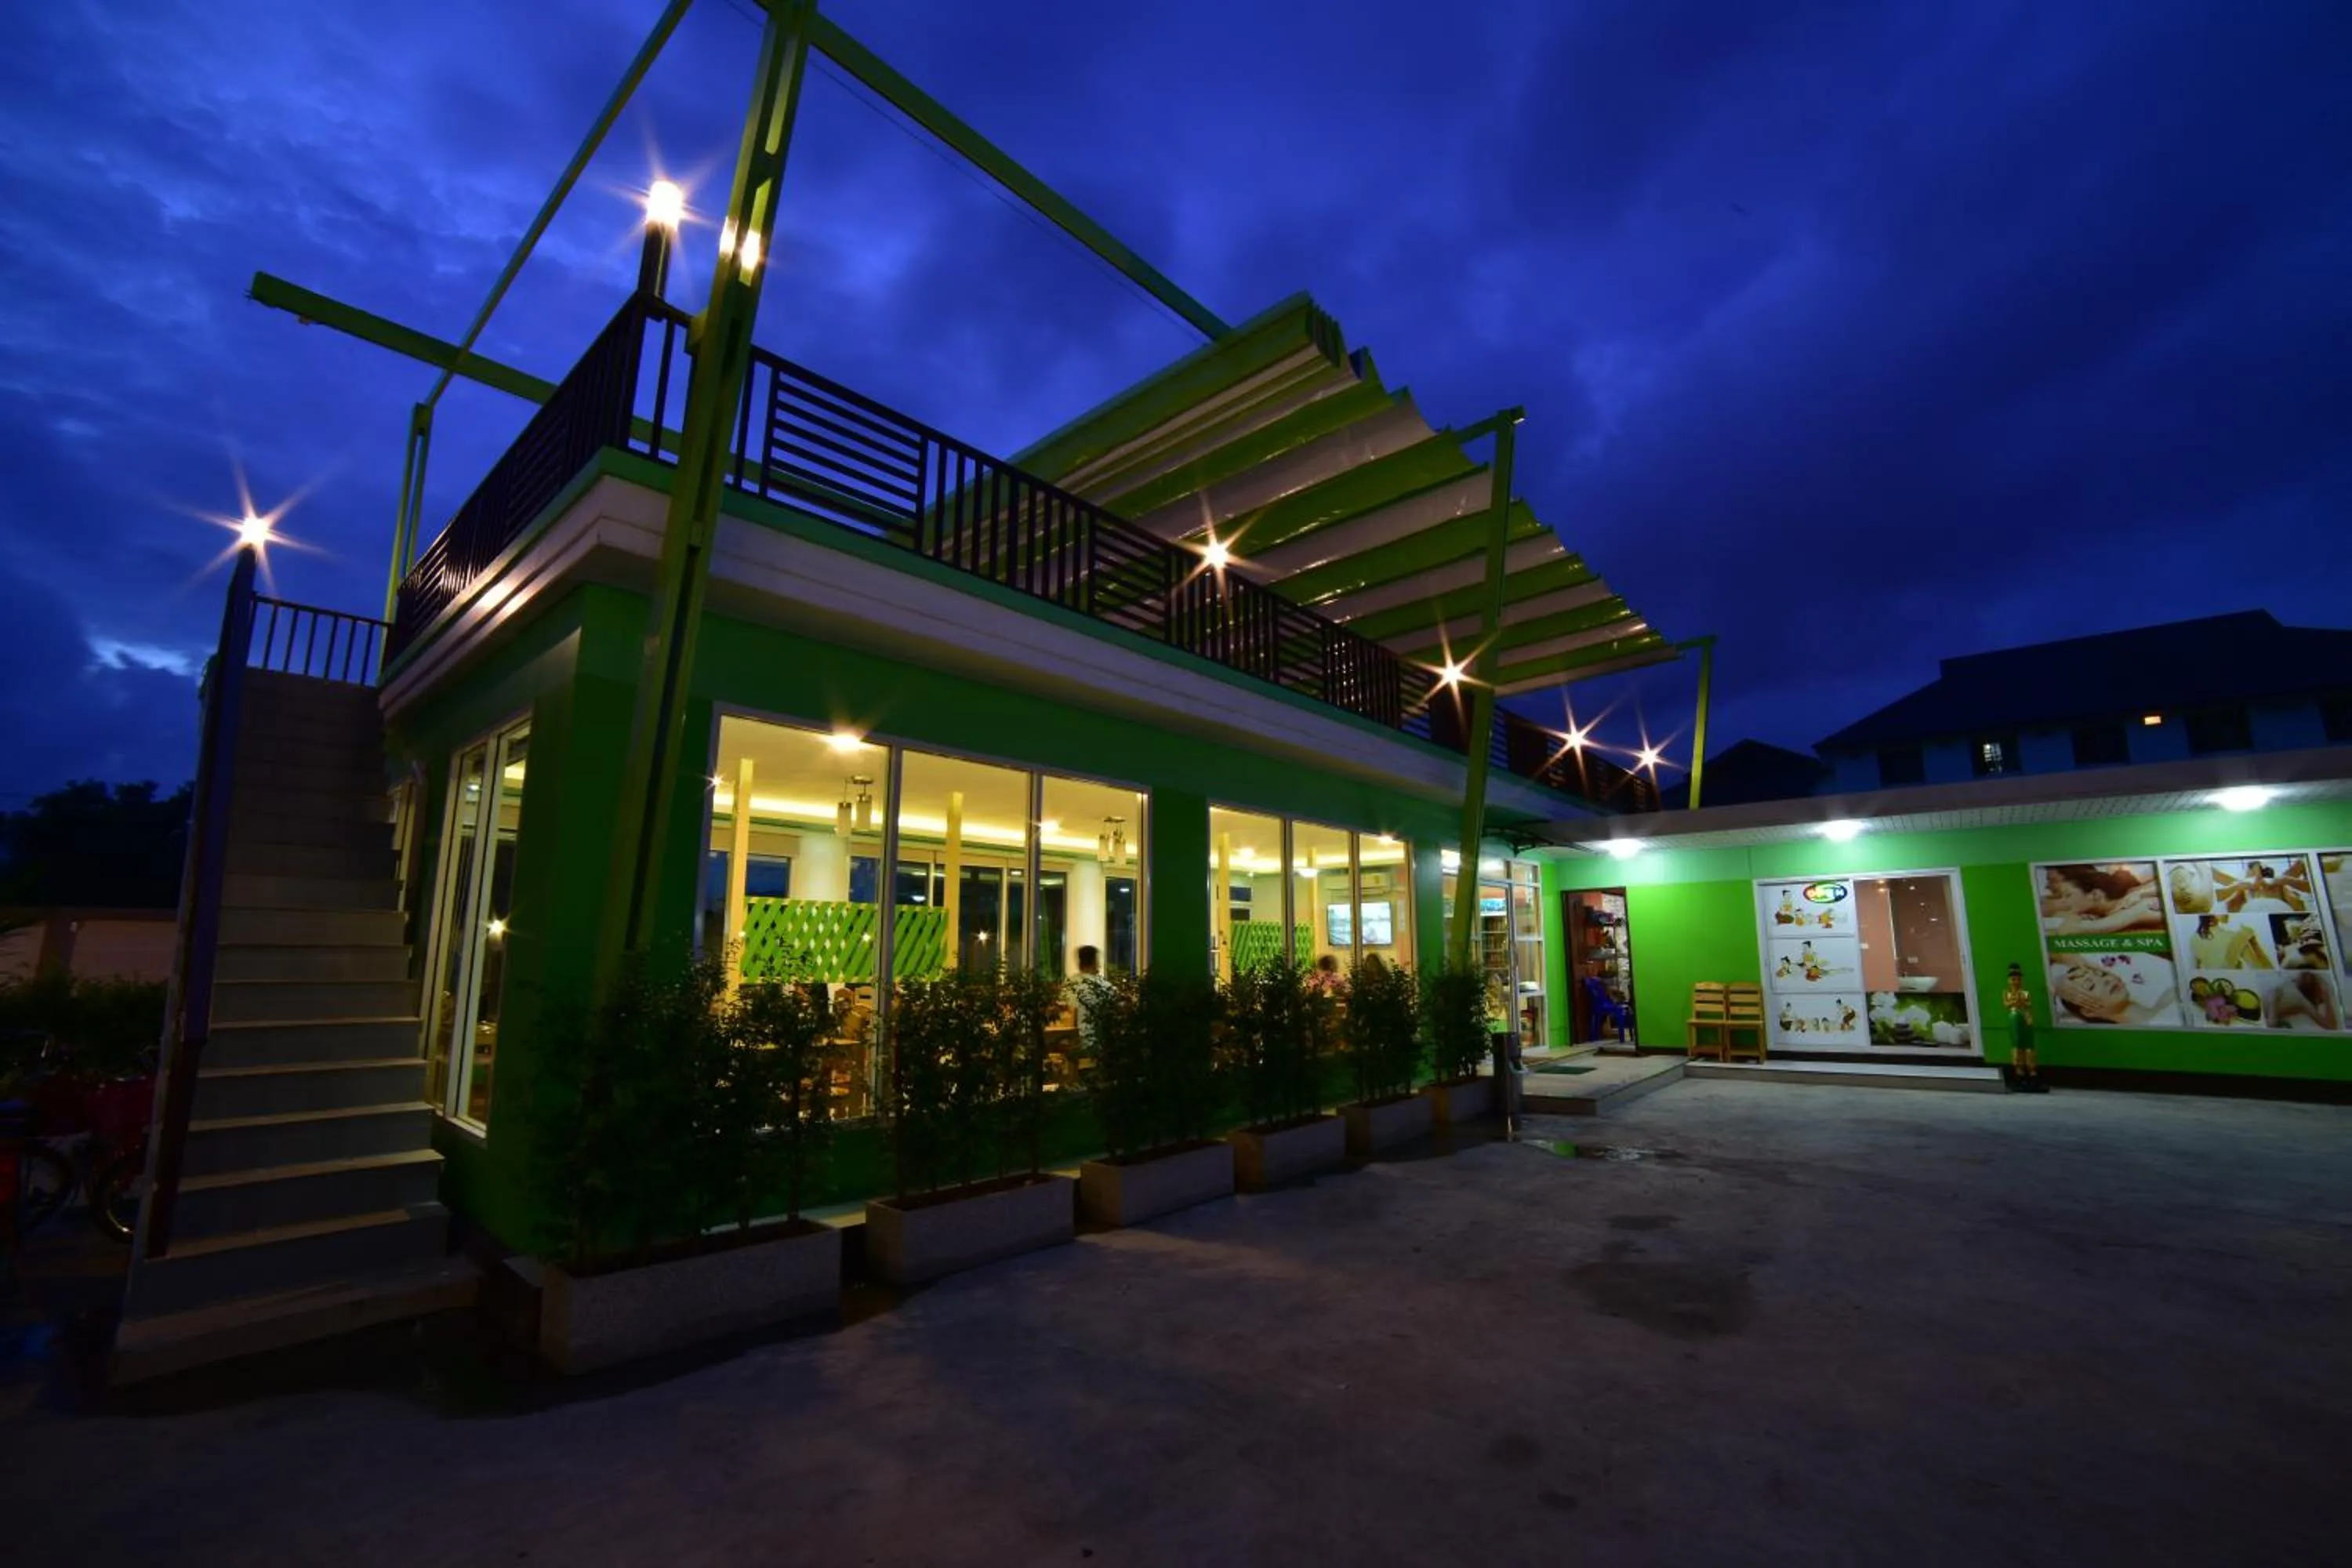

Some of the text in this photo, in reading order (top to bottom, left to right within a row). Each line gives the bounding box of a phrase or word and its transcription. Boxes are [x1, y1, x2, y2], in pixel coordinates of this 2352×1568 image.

[2054, 937, 2163, 948] MASSAGE & SPA
